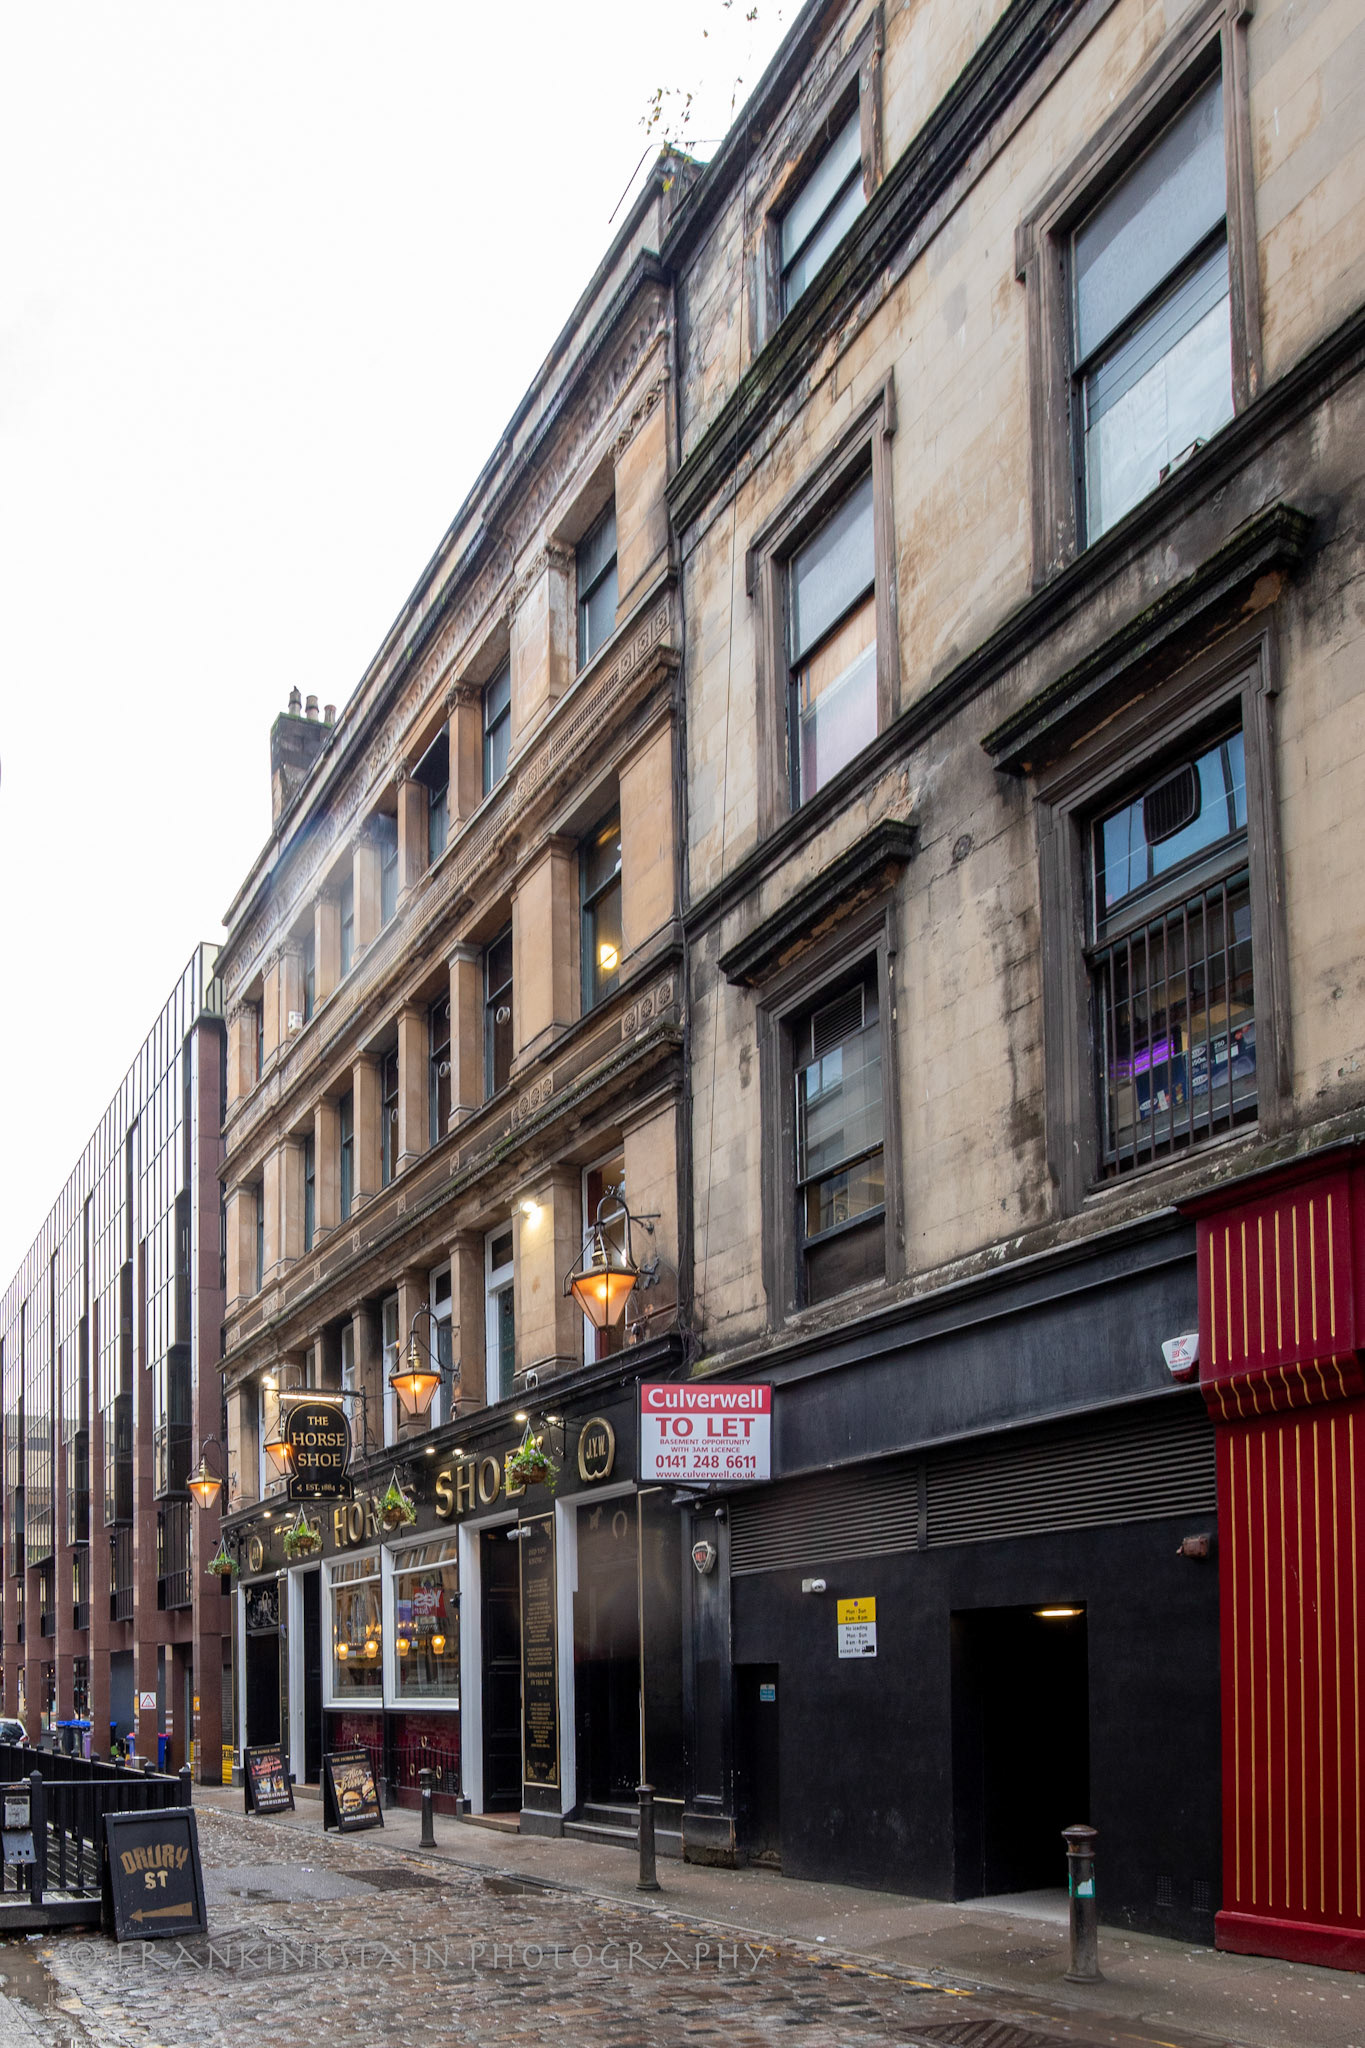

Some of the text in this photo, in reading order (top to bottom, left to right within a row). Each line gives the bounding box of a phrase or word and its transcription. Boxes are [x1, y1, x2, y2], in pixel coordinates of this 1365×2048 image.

[648, 1388, 763, 1408] Culverwell
[307, 1416, 329, 1426] THE
[655, 1417, 755, 1437] TO LET
[291, 1432, 346, 1447] HORSE
[298, 1453, 342, 1467] SHOE
[655, 1455, 756, 1469] 0141 248 6611
[655, 1470, 756, 1479] www.culverwell.co.uk
[120, 1843, 189, 1875] DRURY
[144, 1870, 168, 1890] ST
